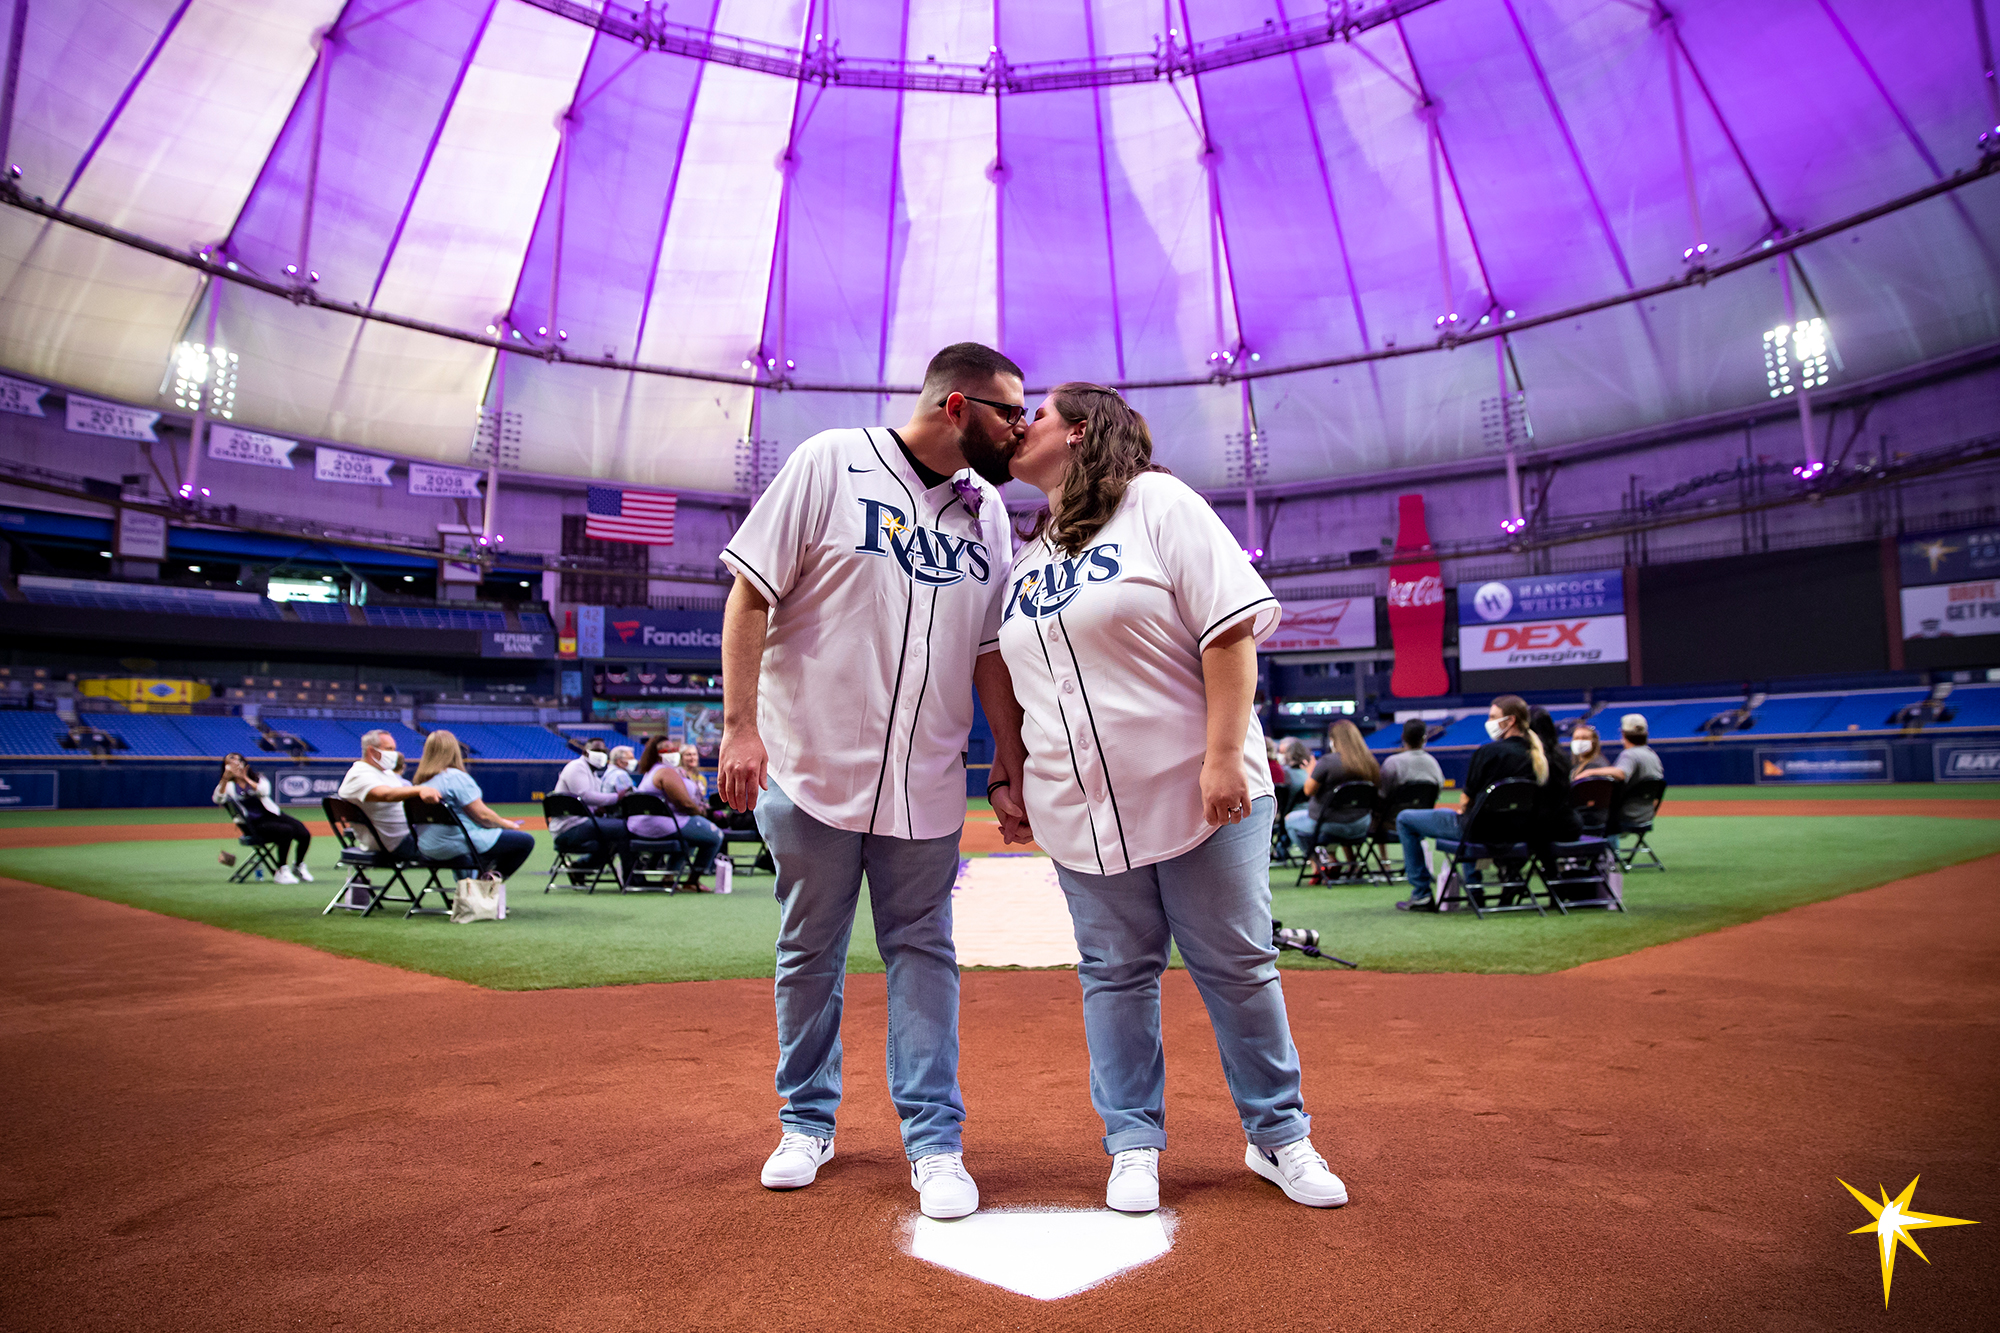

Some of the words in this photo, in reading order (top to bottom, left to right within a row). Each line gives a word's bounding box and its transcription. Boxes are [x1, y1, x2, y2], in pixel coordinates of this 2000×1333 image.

[91, 409, 134, 428] 2011
[229, 438, 272, 455] 2010
[214, 448, 282, 465] CHAMPIONS
[333, 459, 373, 474] 2008
[320, 468, 383, 483] CHAMPIONS
[426, 474, 463, 487] 2008
[413, 483, 473, 496] CHAMPIONS
[855, 497, 991, 586] RAYS
[1000, 543, 1122, 630] RAYS
[1519, 578, 1606, 598] HANCOCK
[1519, 593, 1606, 612] WHITNEY
[1946, 603, 1977, 620] GET
[494, 633, 543, 645] REPUBLIC
[585, 625, 598, 639] 12
[643, 626, 722, 647] Fanatics
[1482, 620, 1591, 653] DEX
[504, 643, 534, 653] BANK
[582, 641, 599, 654] 66
[1508, 650, 1602, 665] imaging
[313, 779, 340, 793] SUN
